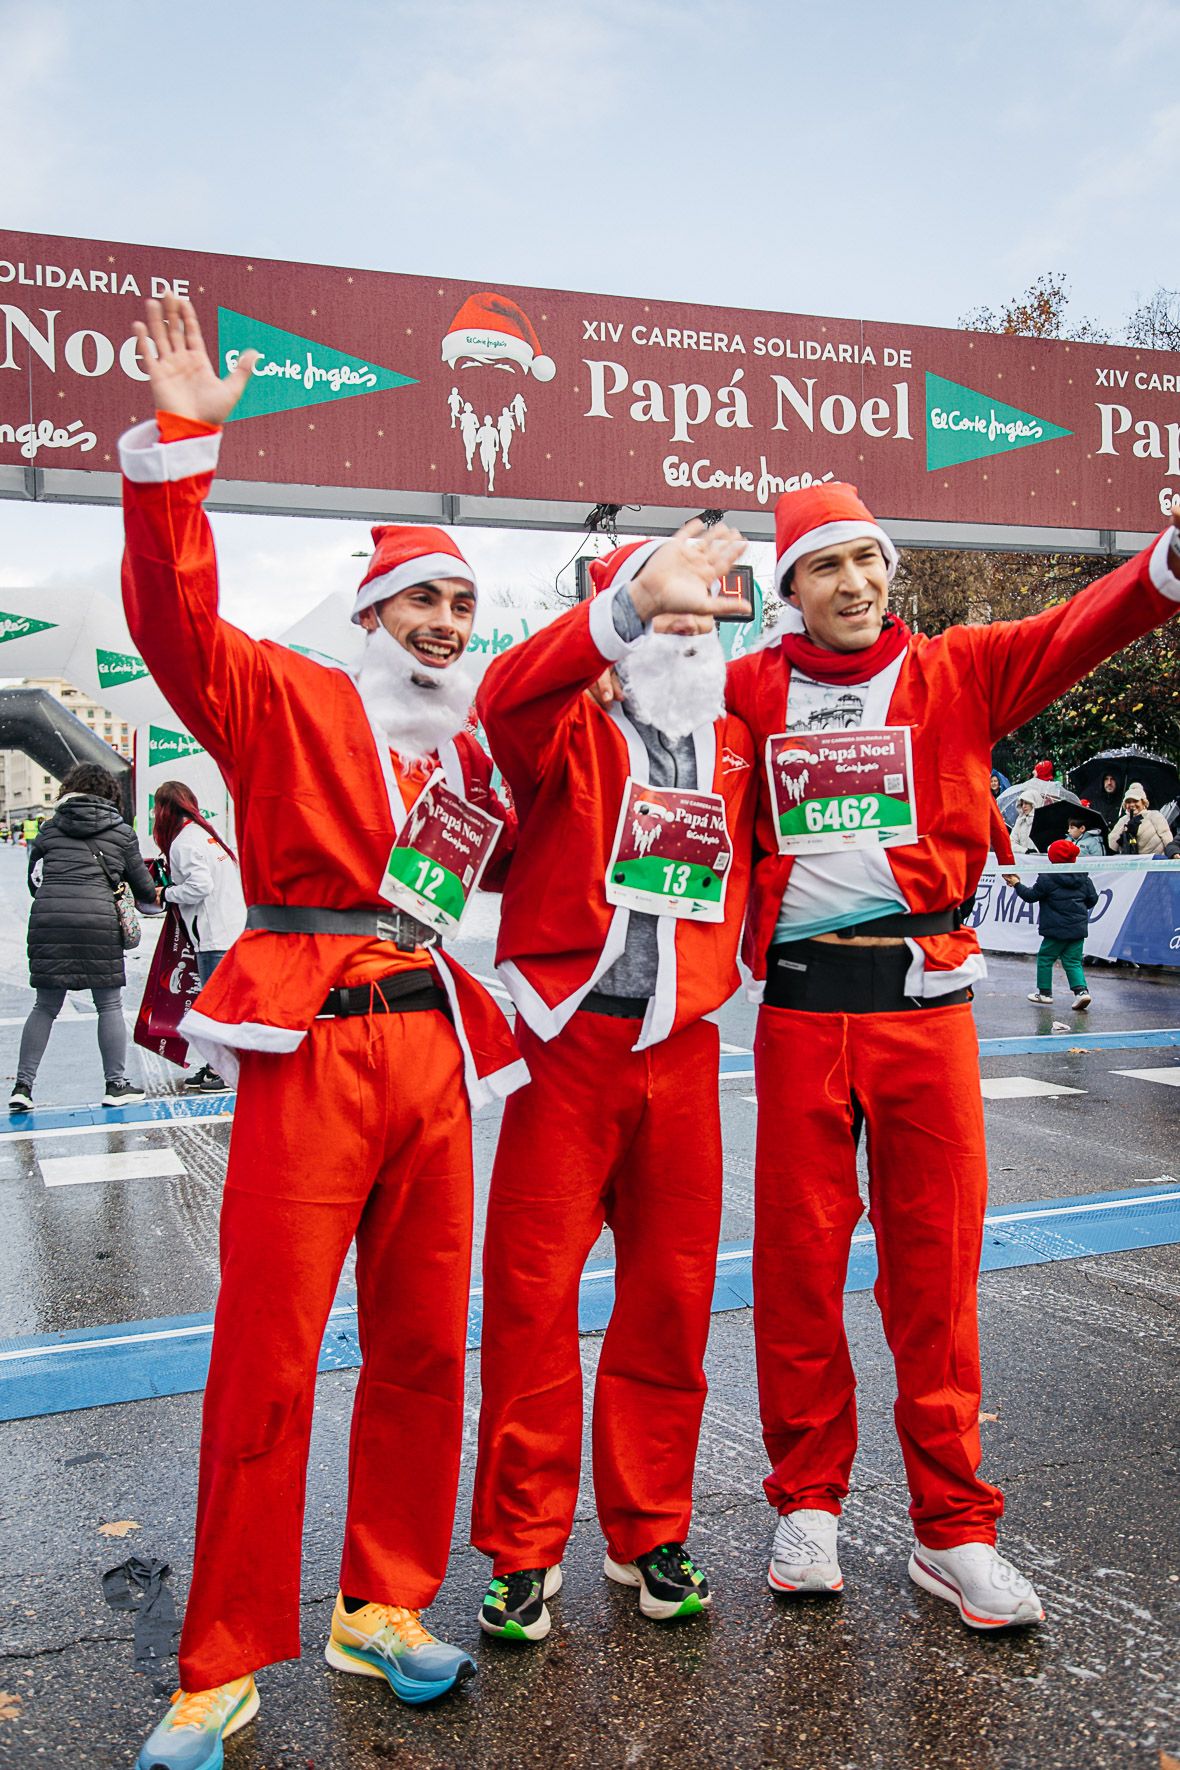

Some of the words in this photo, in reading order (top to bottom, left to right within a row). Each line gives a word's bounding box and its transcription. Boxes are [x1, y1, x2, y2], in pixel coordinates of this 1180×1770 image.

[0, 304, 184, 382] Noe
[582, 320, 624, 343] XIV
[631, 325, 746, 354] CARRERA
[753, 336, 876, 365] SOLIDARIA
[883, 347, 912, 368] DE
[303, 352, 377, 391] Inglés
[1095, 368, 1129, 388] XIV
[1134, 372, 1180, 393] CAR
[582, 358, 754, 443] Papá
[770, 374, 914, 440] Noel
[930, 407, 948, 430] El
[948, 411, 987, 433] Corte
[988, 409, 1043, 443] Inglés
[662, 455, 691, 487] El
[691, 459, 755, 492] Corte
[756, 455, 842, 505] Ingl
[818, 745, 857, 763] Papá
[860, 742, 896, 758] Noel
[674, 807, 709, 829] Papá
[805, 796, 881, 832] 6462
[414, 860, 445, 900] 12
[662, 863, 691, 895] 13
[995, 885, 1114, 924] MAD
